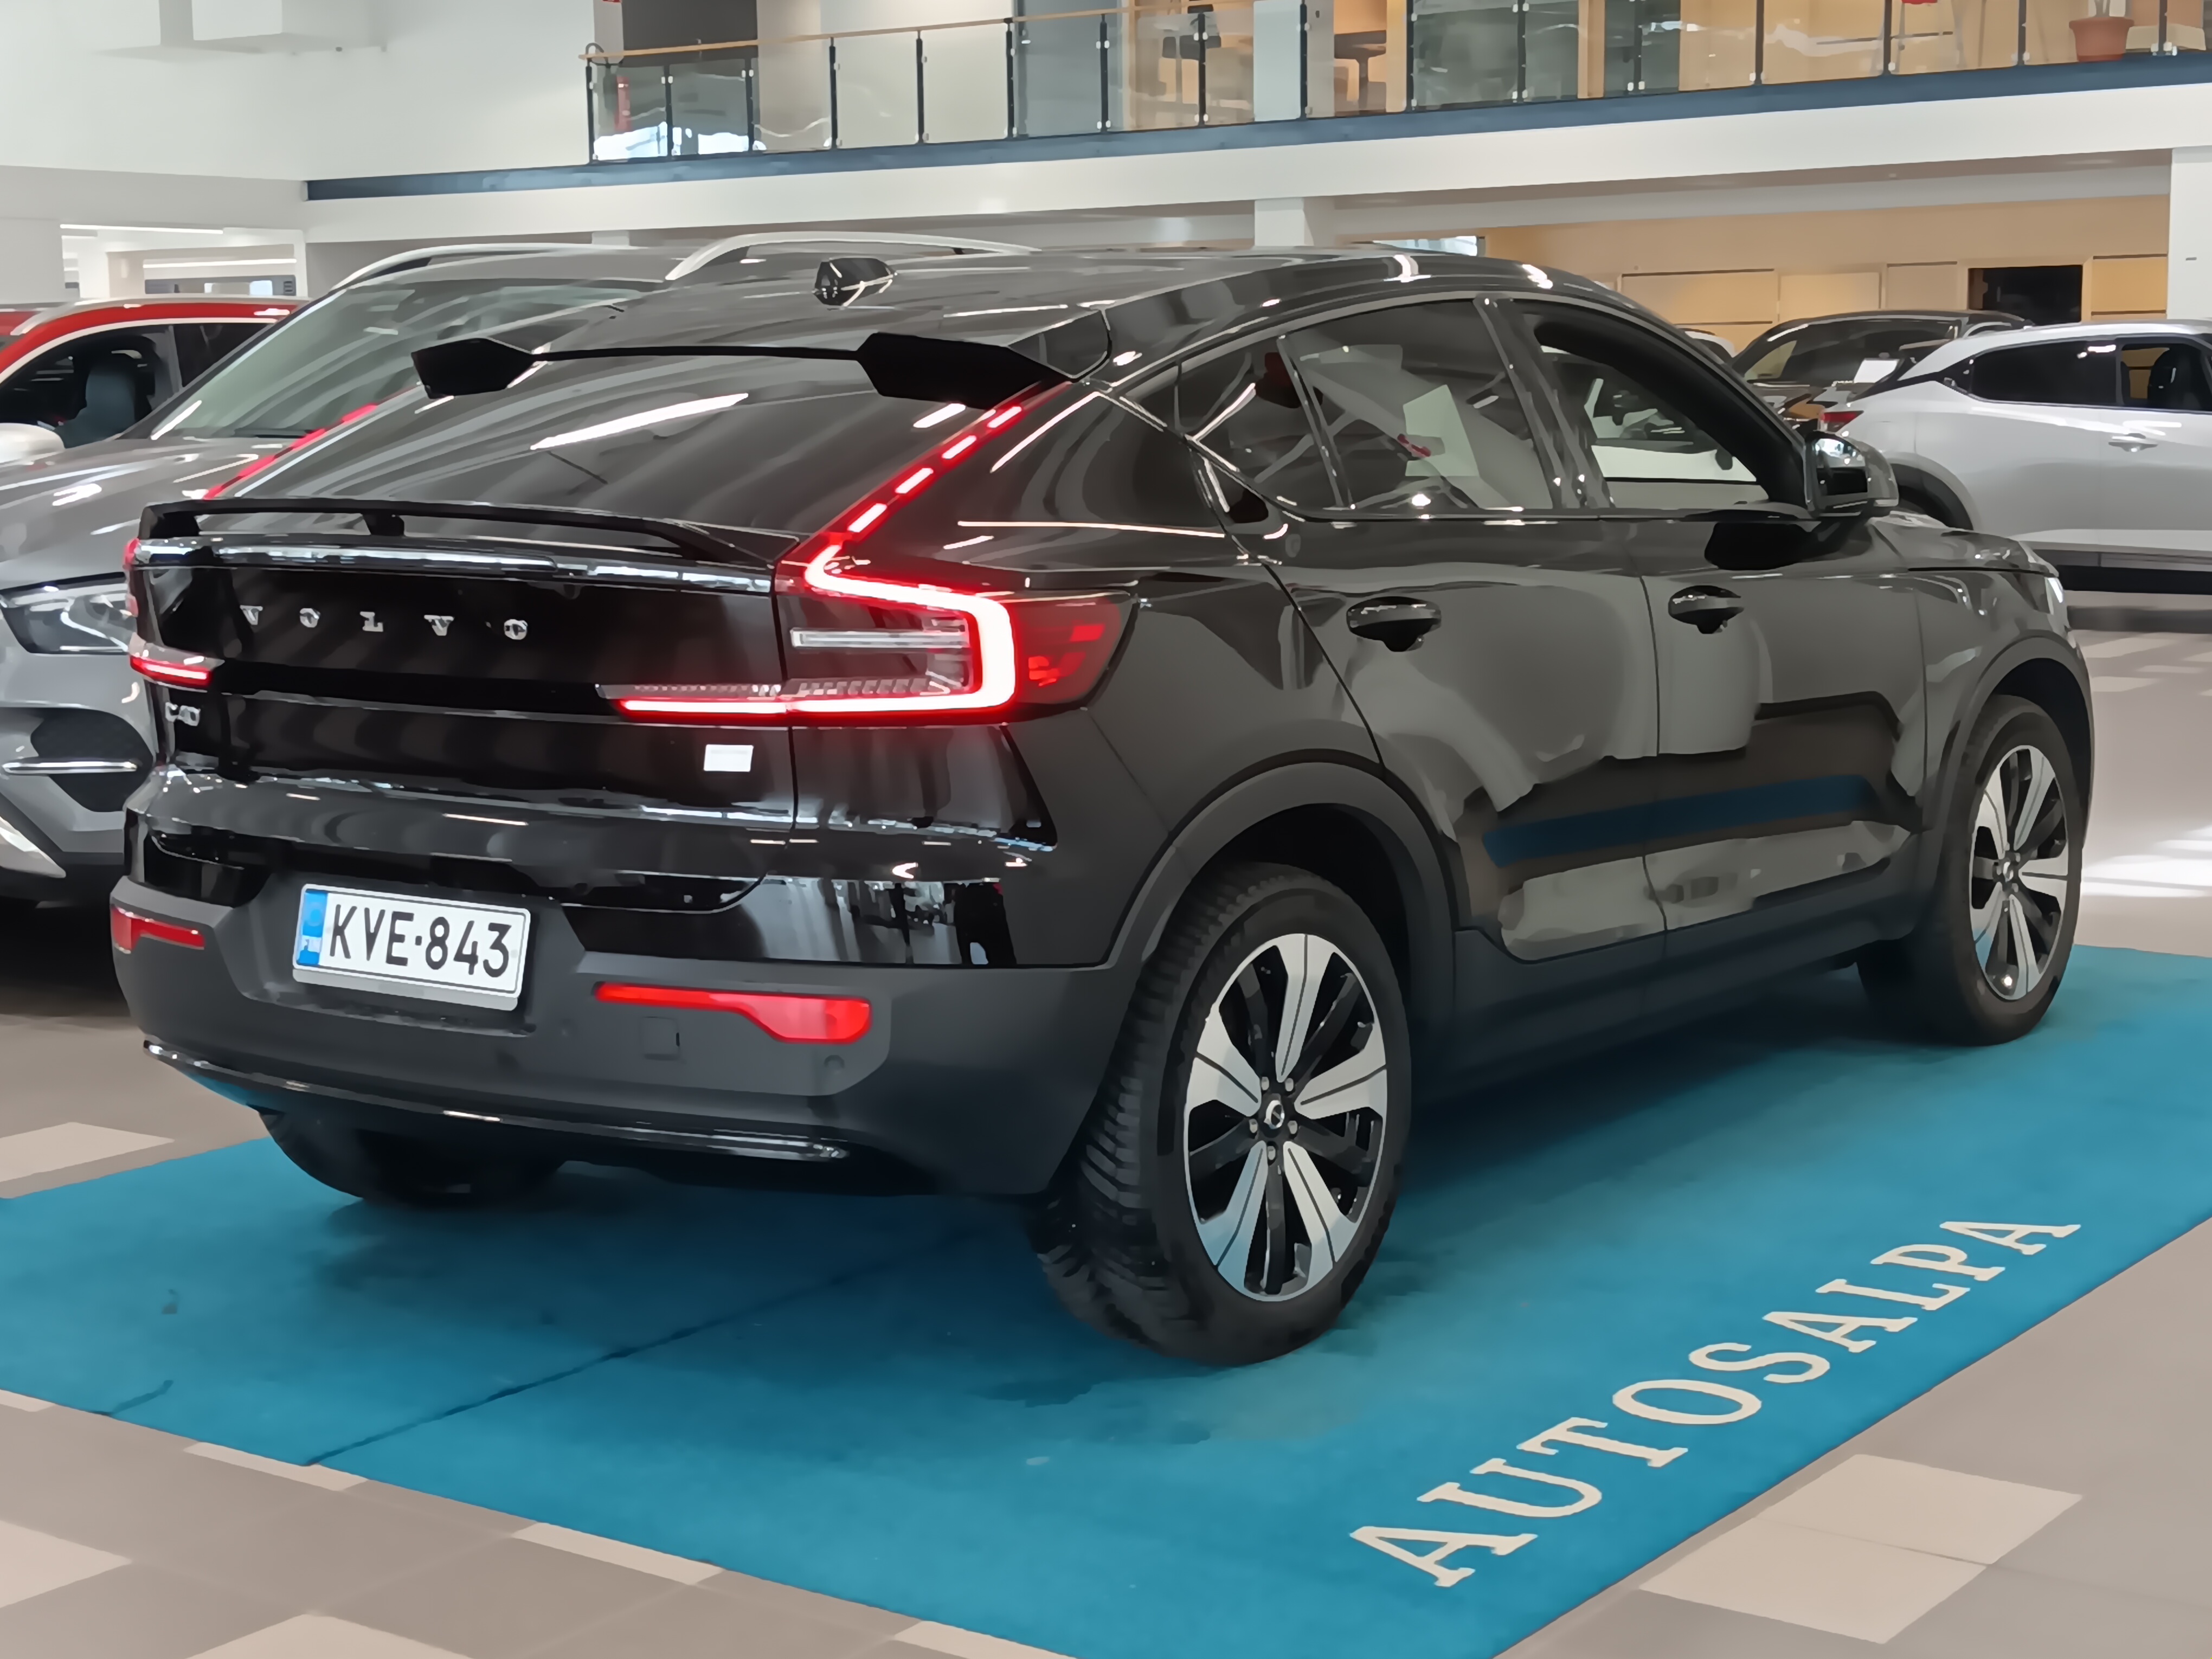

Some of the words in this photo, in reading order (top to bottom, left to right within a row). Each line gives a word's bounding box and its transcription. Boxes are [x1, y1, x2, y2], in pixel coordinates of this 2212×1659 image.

[240, 605, 528, 640] VOLVO
[329, 904, 512, 978] KVE-843
[1349, 1220, 2081, 1587] AUTOSALPA
